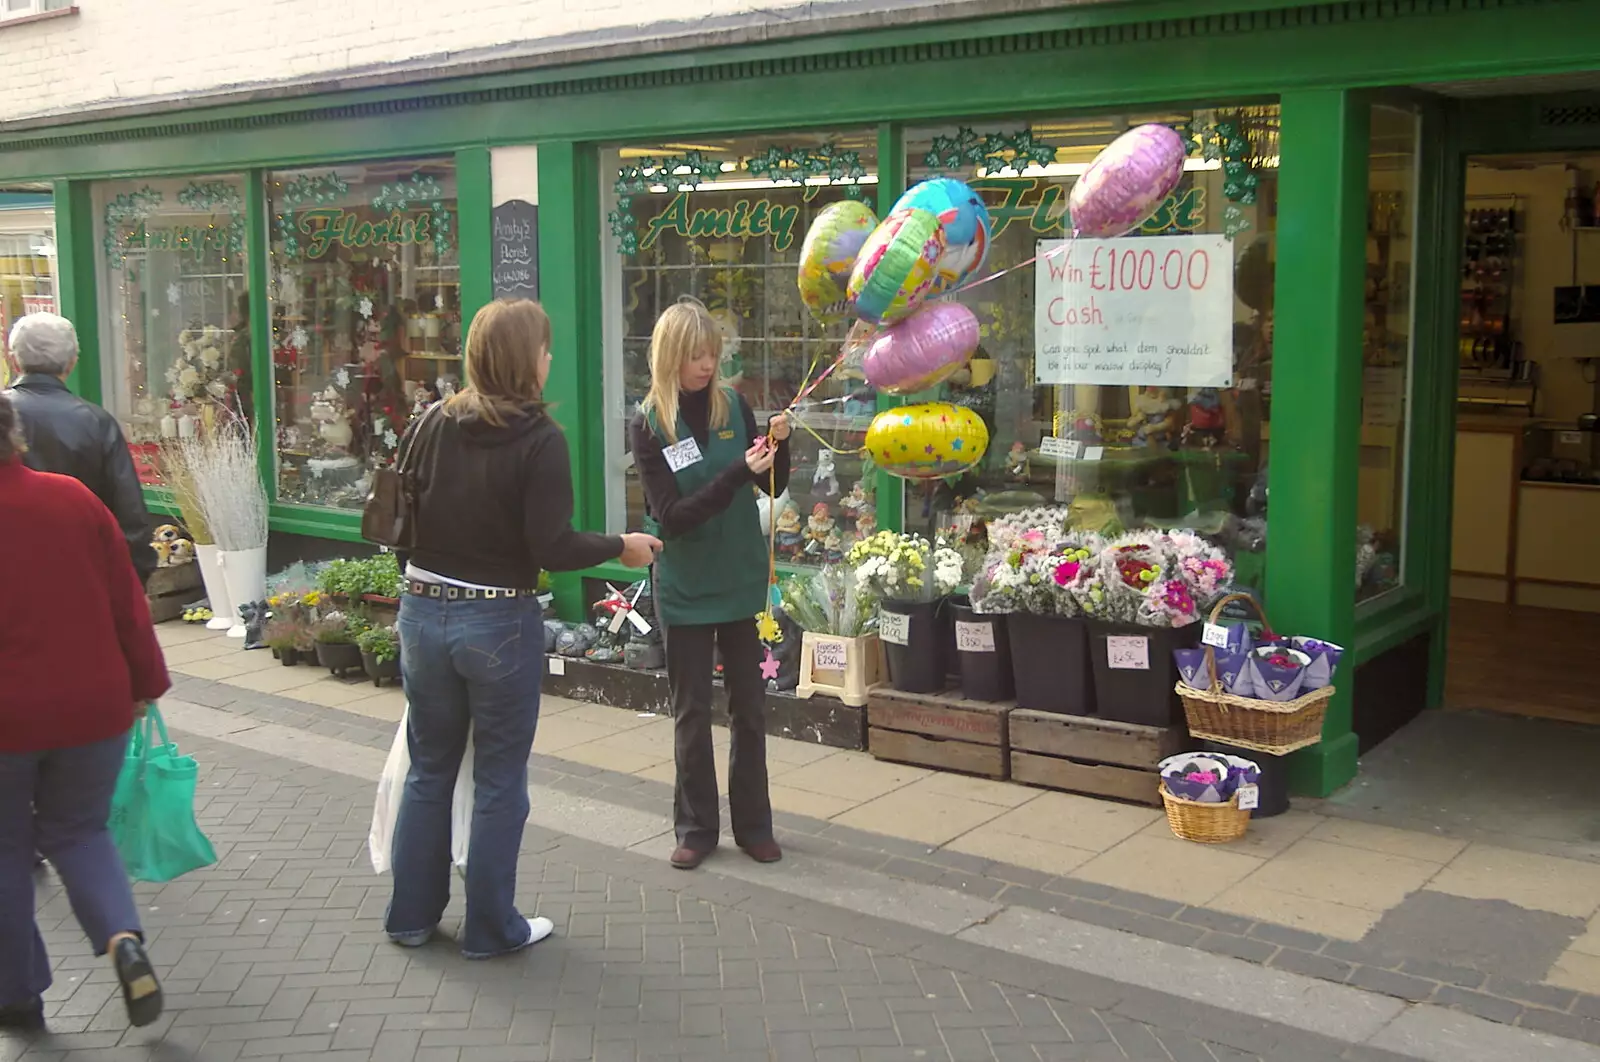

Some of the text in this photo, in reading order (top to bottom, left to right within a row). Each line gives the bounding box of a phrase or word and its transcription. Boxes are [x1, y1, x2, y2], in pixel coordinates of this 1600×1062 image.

[966, 177, 1206, 243] Flst
[125, 221, 227, 263] Amity's
[299, 208, 430, 259] Florist
[1046, 250, 1083, 283] Win
[1047, 296, 1103, 326] Cash
[1106, 341, 1129, 353] what
